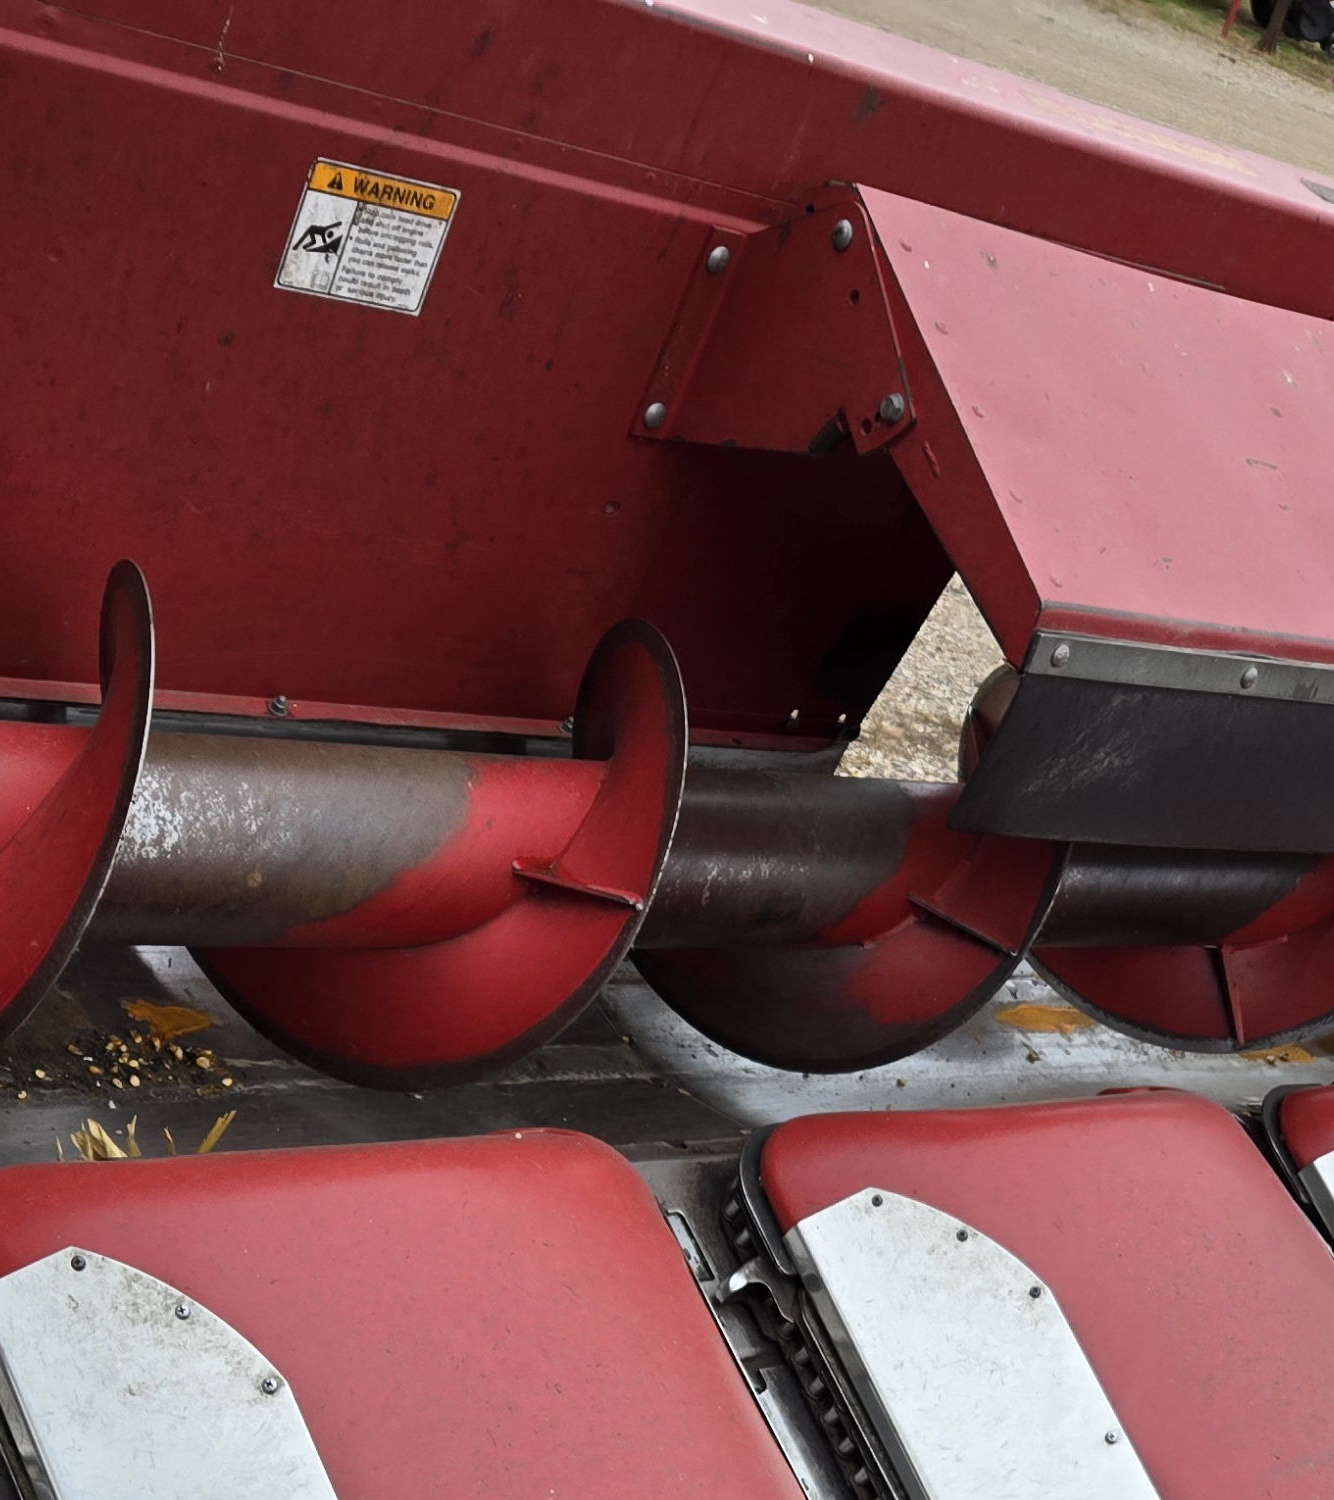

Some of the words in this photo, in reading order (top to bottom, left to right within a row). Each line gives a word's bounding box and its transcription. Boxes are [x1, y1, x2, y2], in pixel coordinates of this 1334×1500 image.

[354, 176, 436, 211] WARNING
[402, 226, 423, 237] engine
[341, 265, 365, 277] Failure
[367, 270, 375, 279] to
